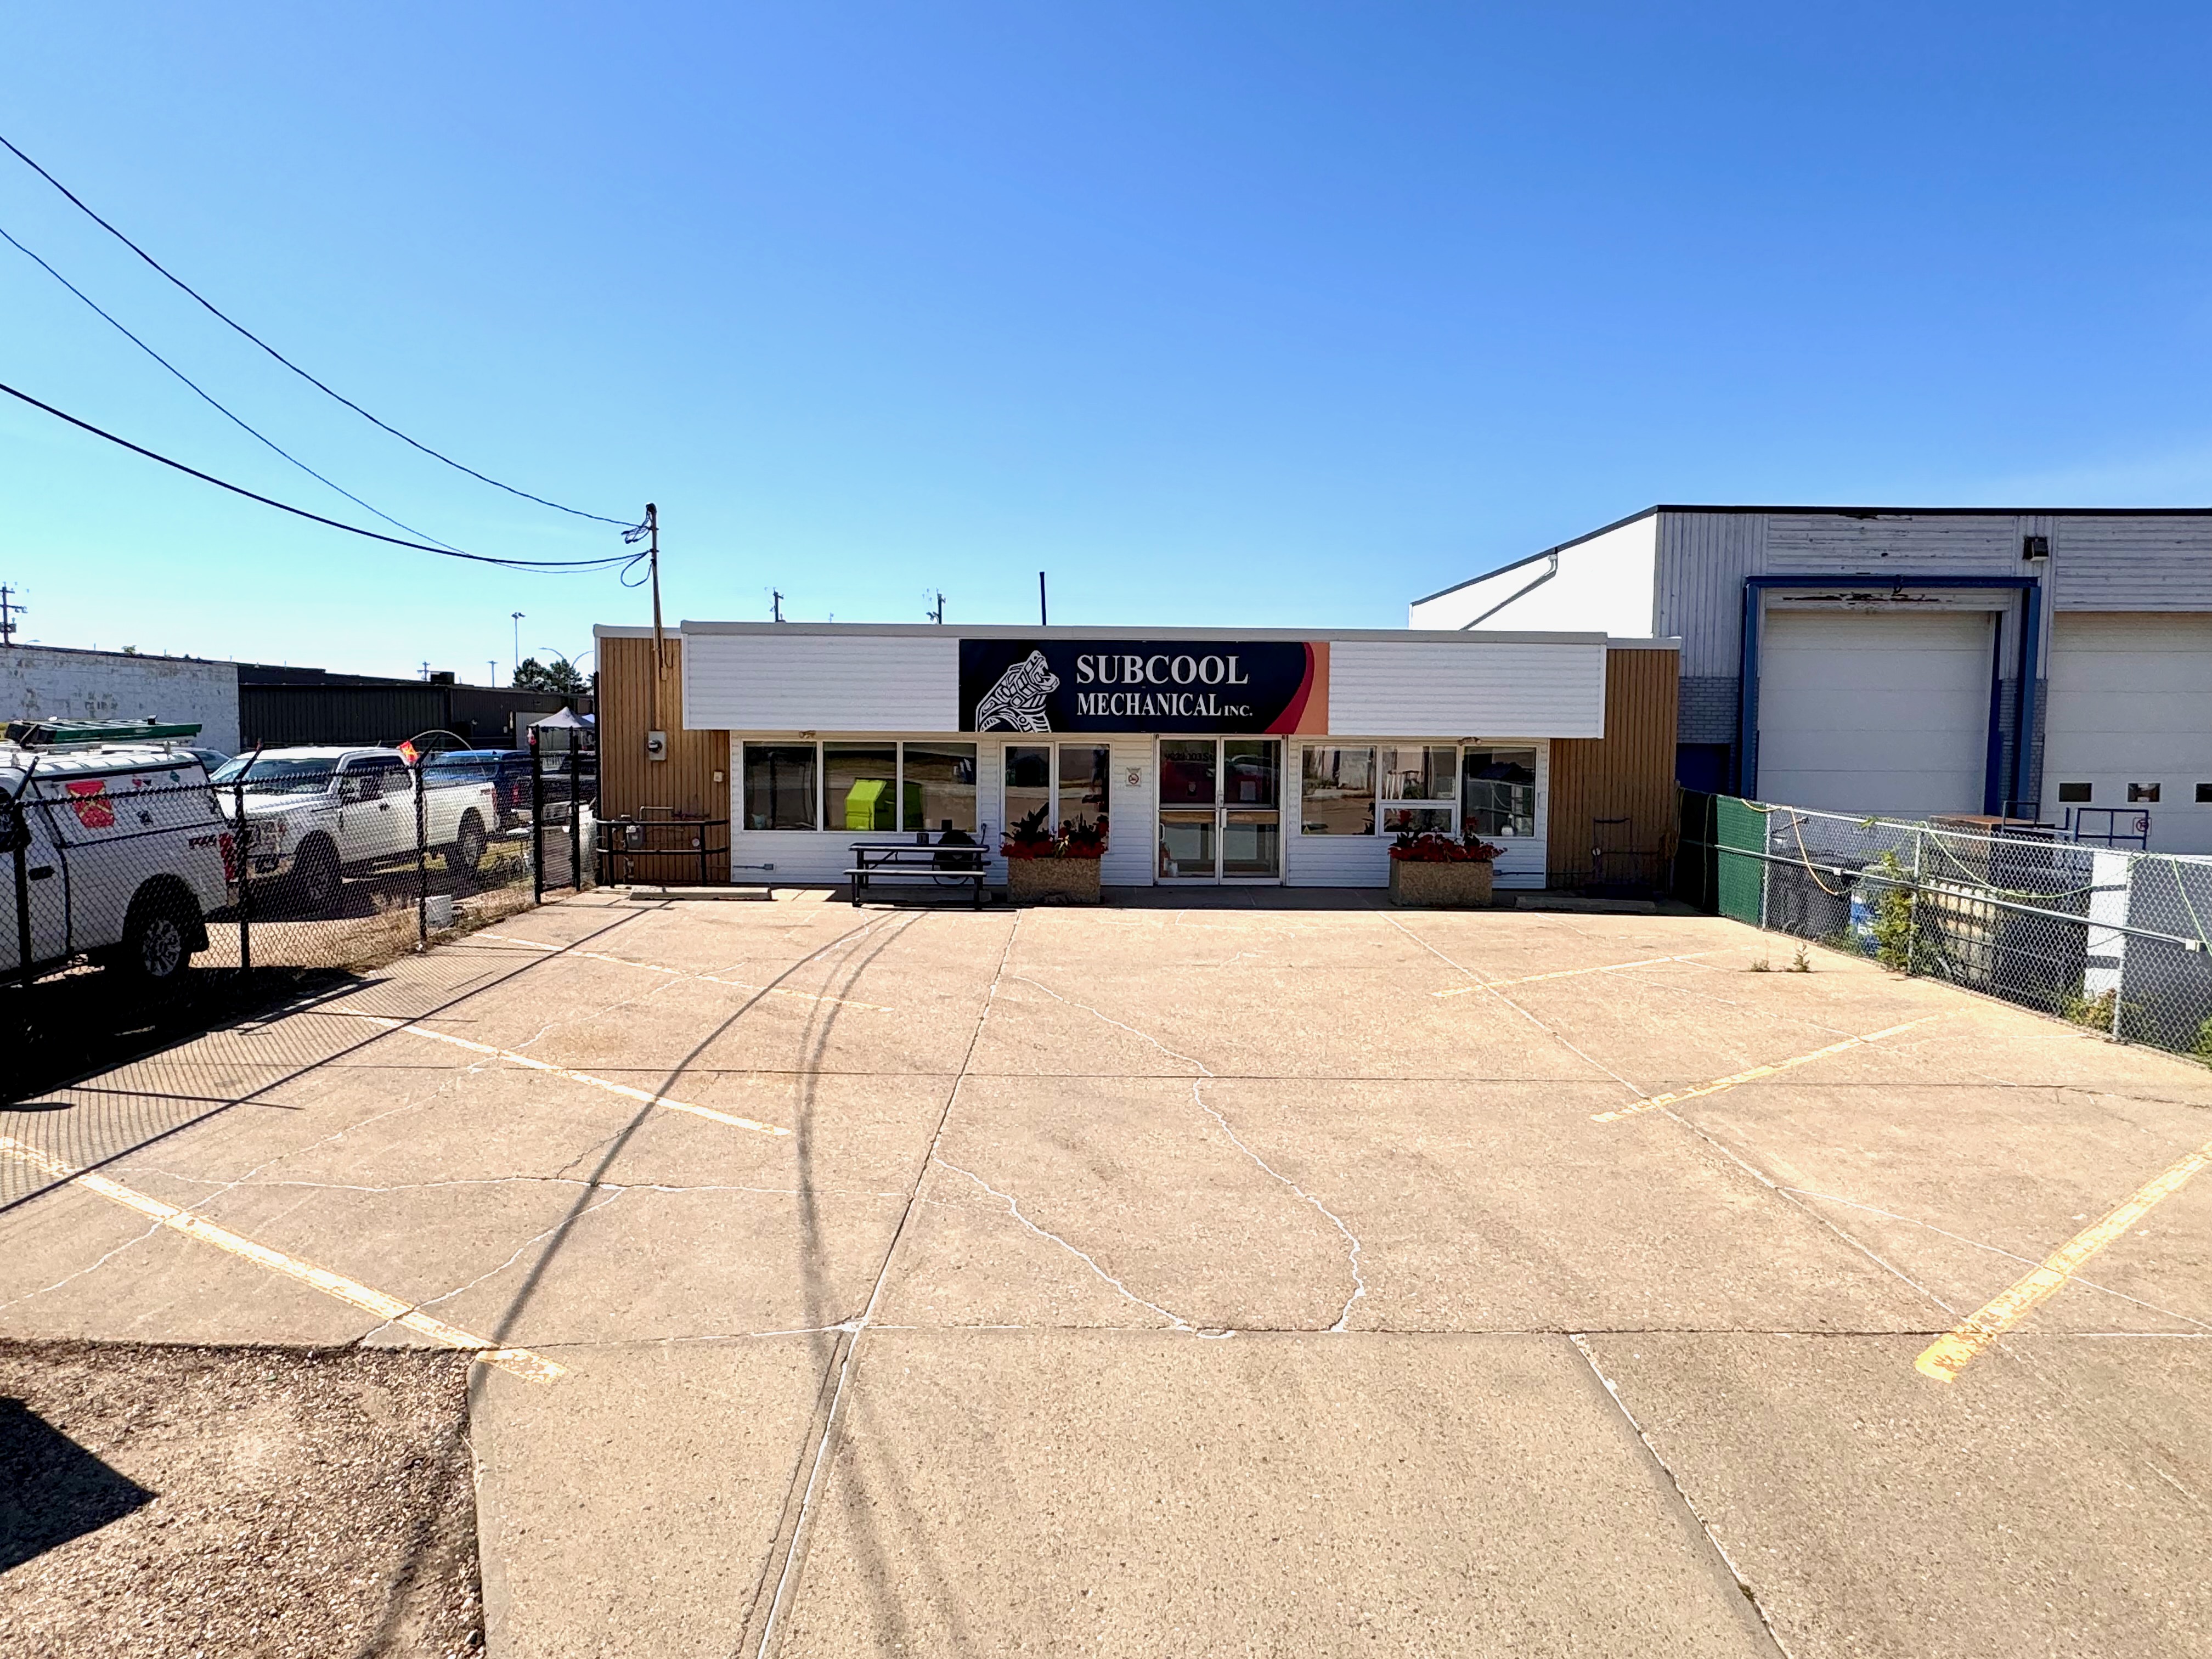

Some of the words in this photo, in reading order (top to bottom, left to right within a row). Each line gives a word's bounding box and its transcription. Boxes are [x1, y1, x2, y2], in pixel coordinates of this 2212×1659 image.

[1077, 654, 1249, 684] SUBCOOL
[1077, 693, 1222, 716] MECHANICAL
[1224, 705, 1252, 716] INC.
